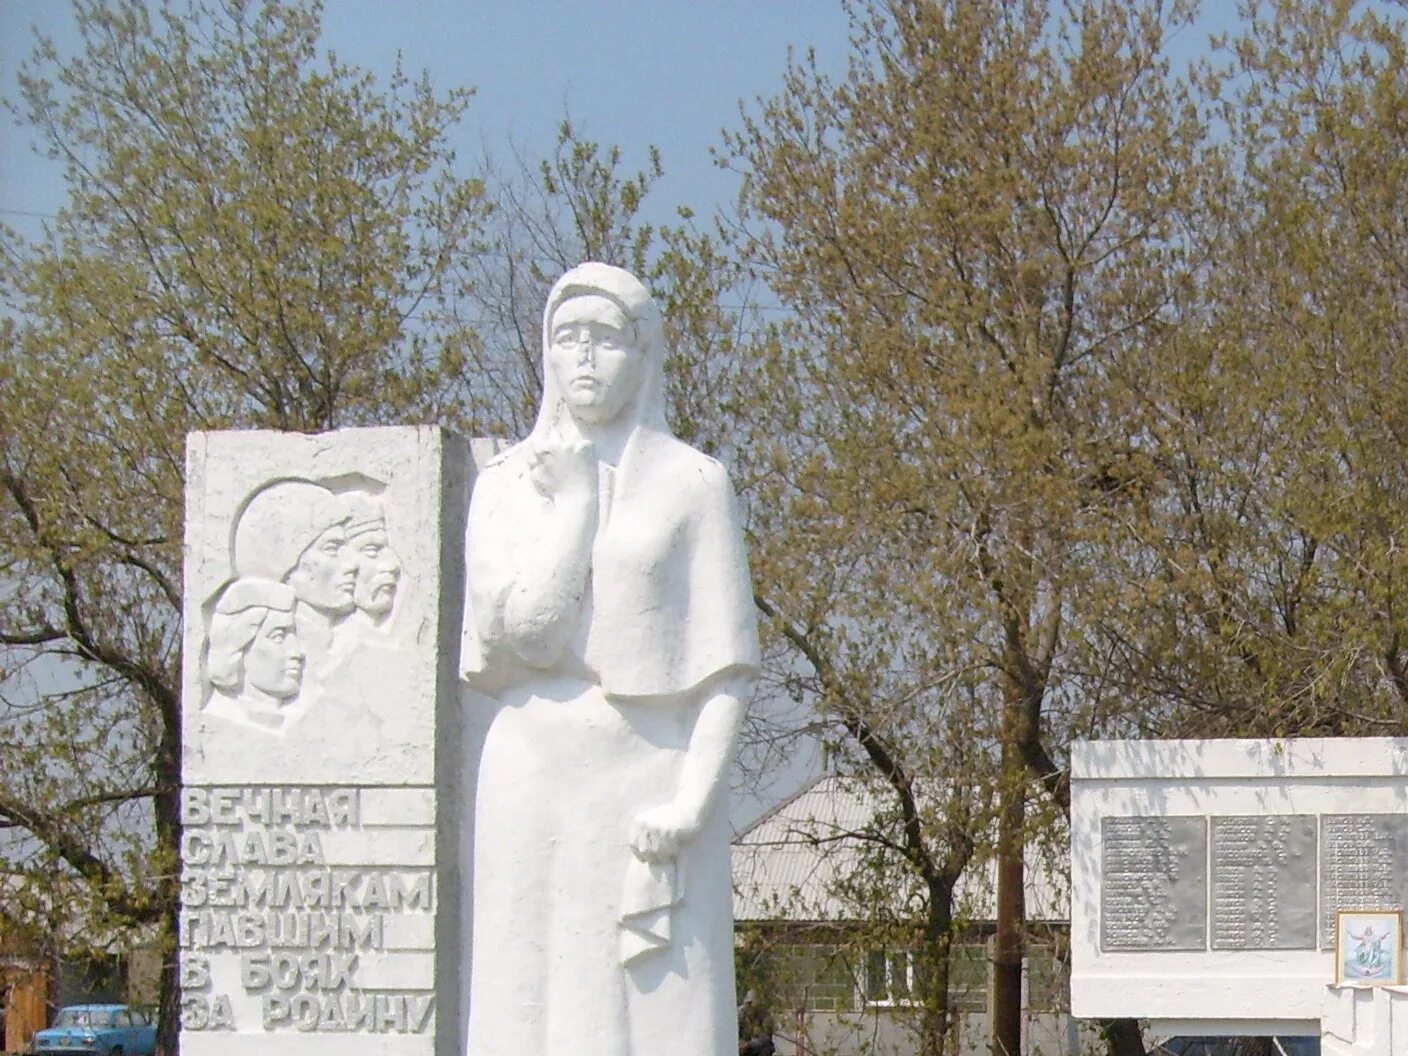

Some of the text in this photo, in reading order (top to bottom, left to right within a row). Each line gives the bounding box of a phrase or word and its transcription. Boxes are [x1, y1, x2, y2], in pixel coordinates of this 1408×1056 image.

[182, 788, 358, 827] ВЕЧНАЯ
[182, 829, 325, 866] СЛАВА
[182, 870, 432, 910] ЗЕМЛЯКАМ
[182, 912, 383, 949] ПАВШИМ
[182, 952, 359, 990] В БОЯХ
[182, 993, 436, 1033] ЗА РОДИНУ
